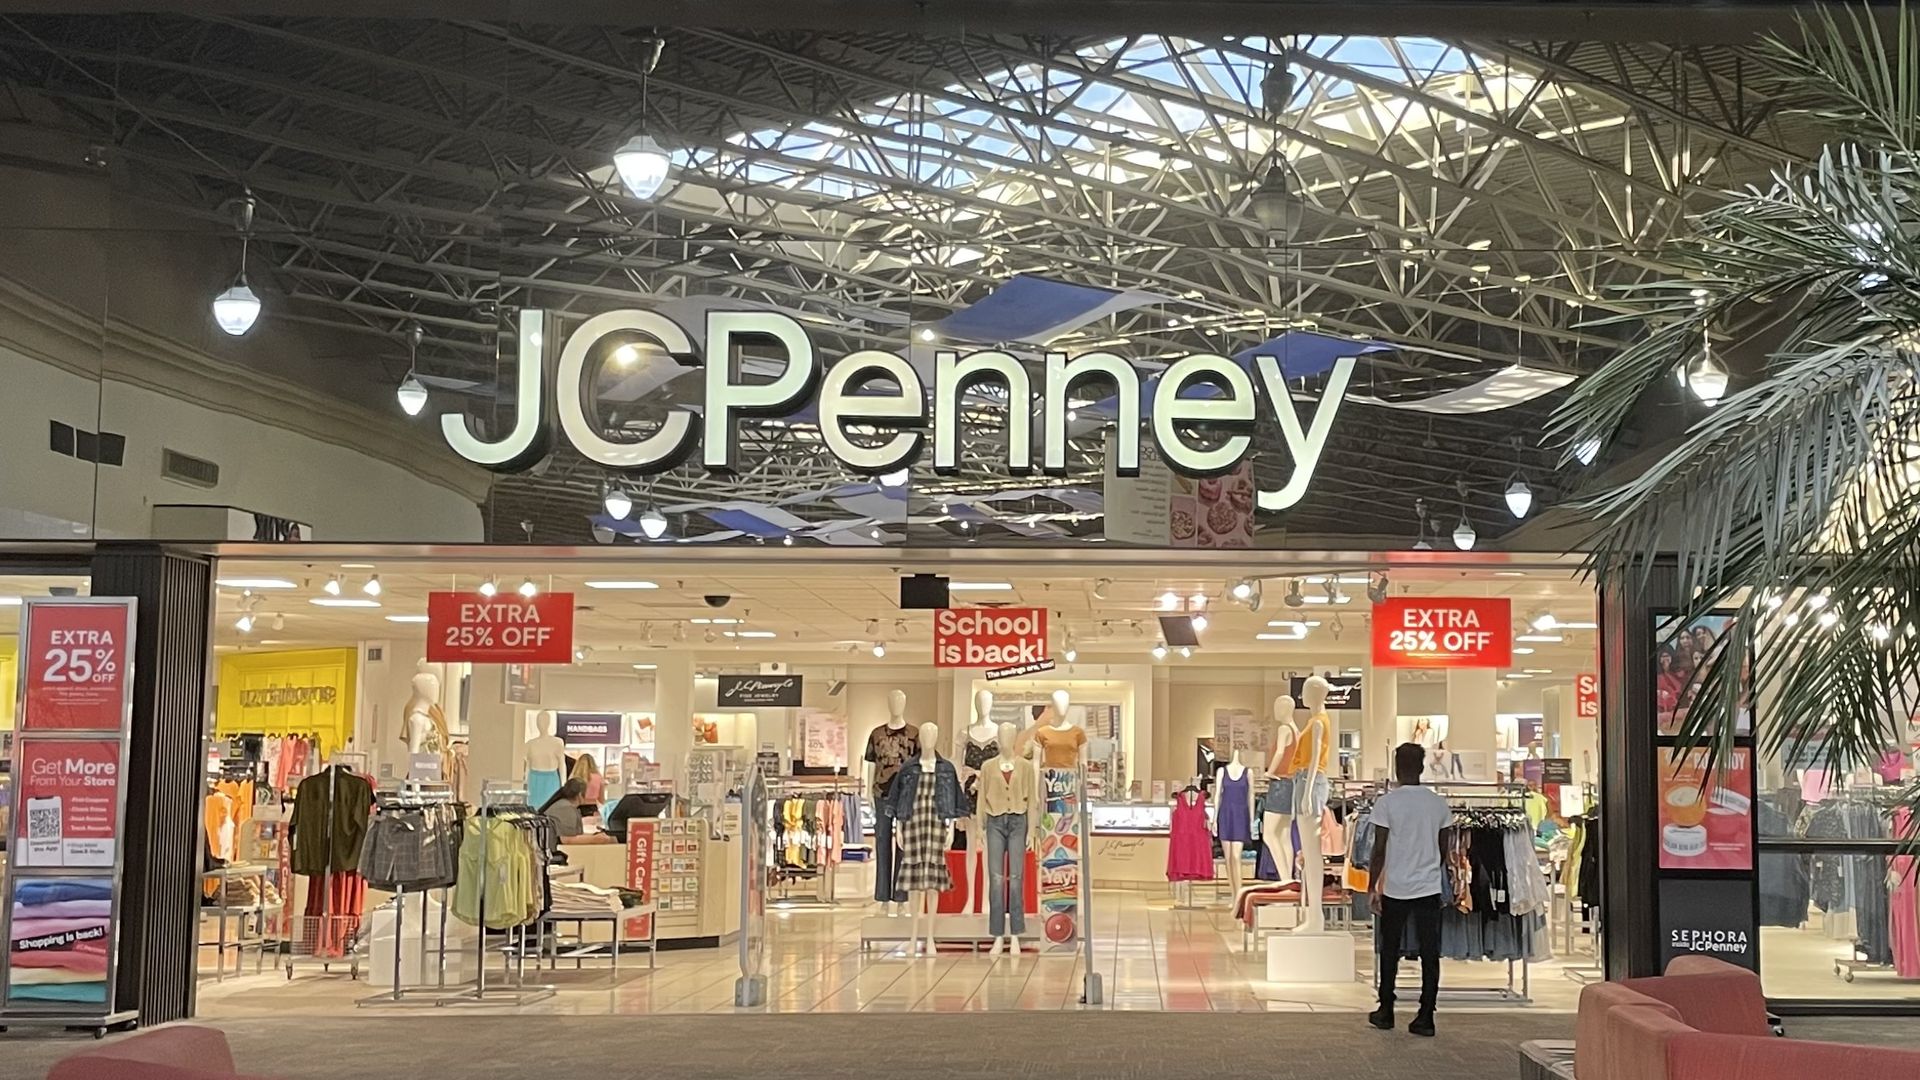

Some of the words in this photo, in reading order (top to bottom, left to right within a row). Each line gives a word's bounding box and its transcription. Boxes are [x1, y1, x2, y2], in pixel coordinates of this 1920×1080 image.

[440, 308, 1357, 512] JCPenney
[461, 604, 539, 623] EXTRA
[938, 609, 1039, 636] School
[1403, 609, 1480, 628] EXTRA
[51, 630, 113, 645] EXTRA
[445, 627, 494, 646] 25%
[1389, 631, 1438, 651] 25%
[938, 638, 961, 664] is
[966, 638, 1044, 664] back!
[43, 648, 116, 682] 25%
[986, 671, 1000, 679] The
[1000, 667, 1026, 675] savings
[92, 674, 116, 683] OFF
[31, 758, 63, 775] Get
[65, 758, 116, 775] More
[30, 775, 57, 786] From
[59, 775, 82, 786] Your
[83, 775, 116, 786] Store
[1045, 777, 1076, 796] Yay!
[636, 837, 648, 863] Gift
[19, 934, 65, 950] Shopping
[65, 932, 75, 942] is
[75, 927, 103, 940] back!
[1671, 930, 1748, 943] SEPHORA
[1690, 941, 1747, 954] JCPenney
